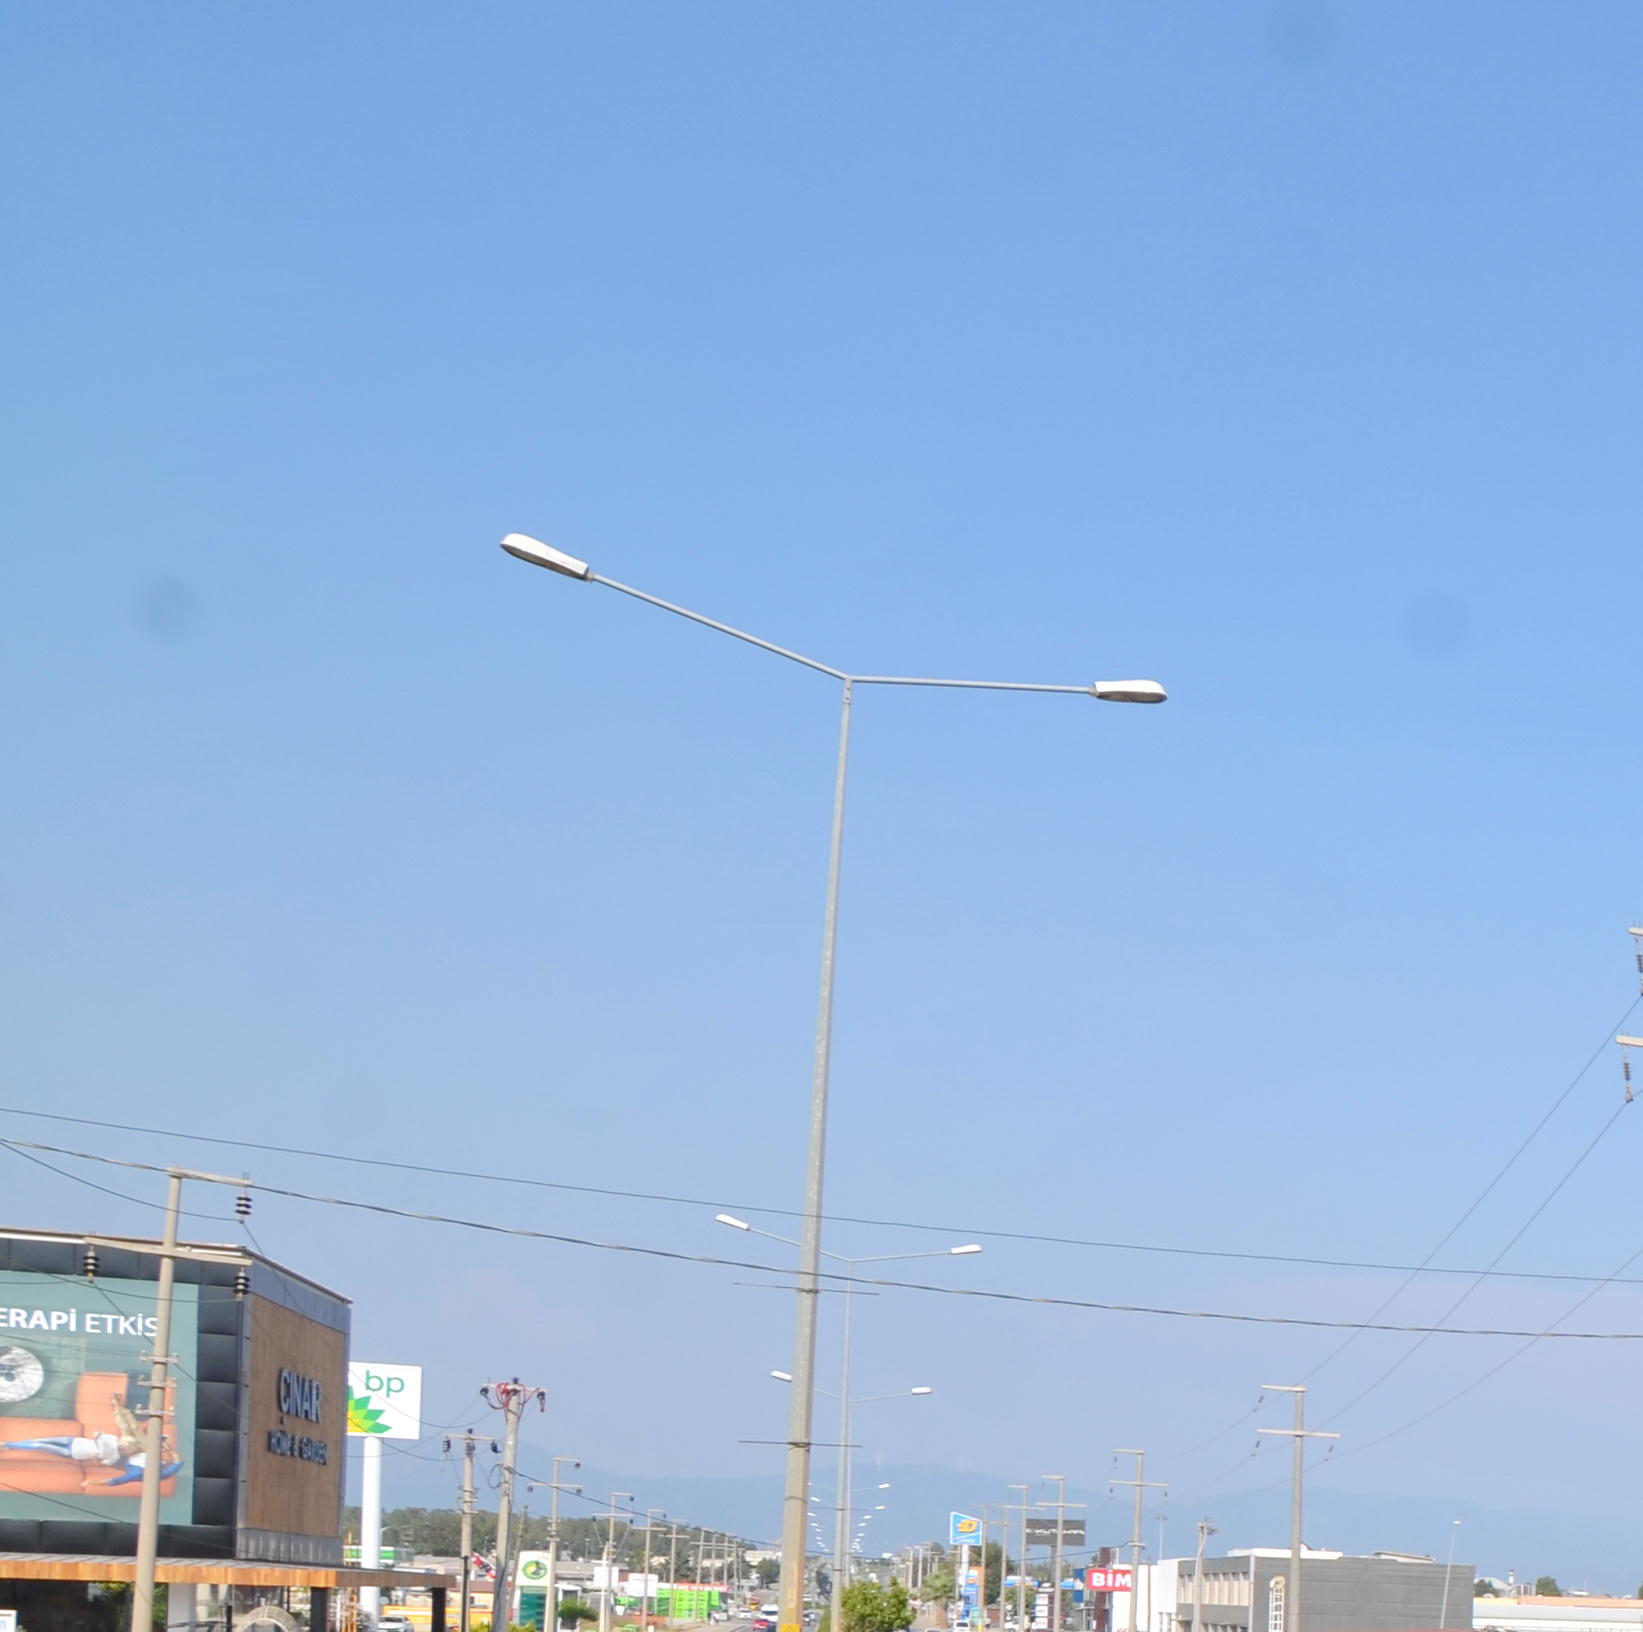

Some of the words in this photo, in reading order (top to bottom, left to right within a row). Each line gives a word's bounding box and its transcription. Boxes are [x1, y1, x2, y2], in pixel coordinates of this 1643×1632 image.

[279, 1367, 322, 1425] ÇINAR
[365, 1370, 405, 1398] bp
[1091, 1570, 1132, 1588] BİM
